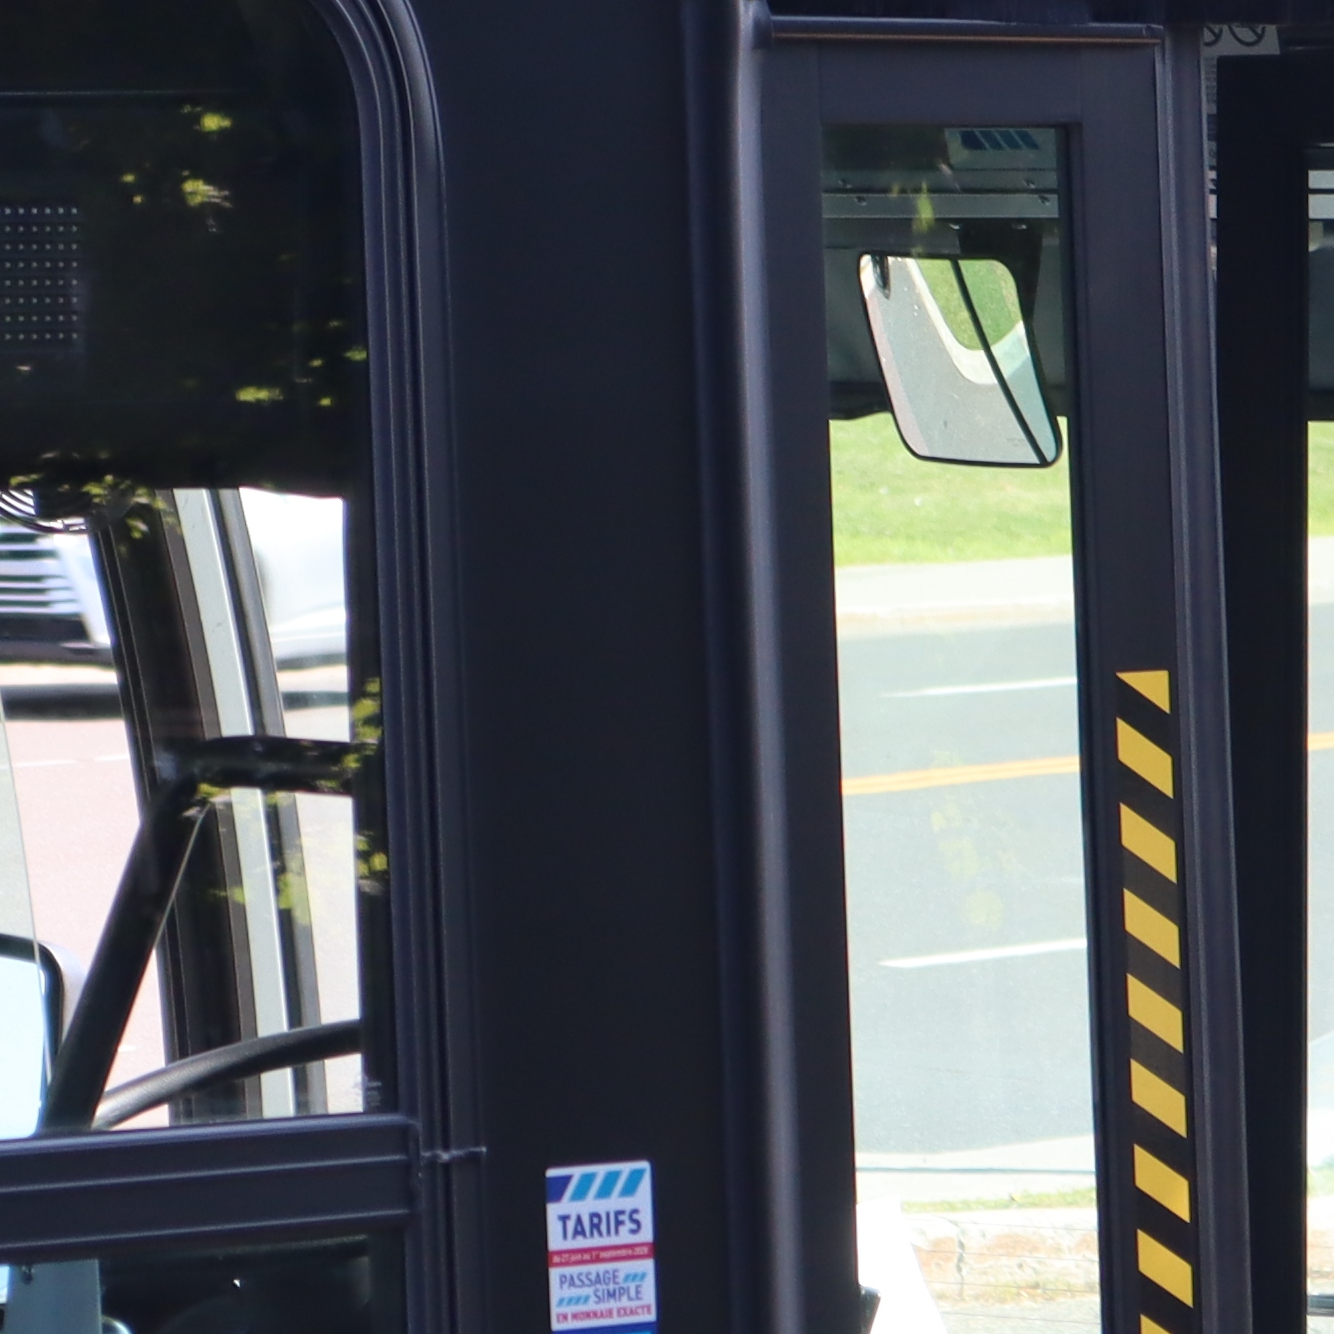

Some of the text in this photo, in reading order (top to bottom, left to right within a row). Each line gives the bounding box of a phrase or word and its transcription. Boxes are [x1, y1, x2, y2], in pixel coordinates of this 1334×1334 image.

[557, 1208, 642, 1241] TARIFS
[559, 1269, 620, 1289] PASSAGE
[593, 1284, 643, 1305] SIMPLE
[556, 1304, 653, 1324] EN MONNAIE EXACTE
